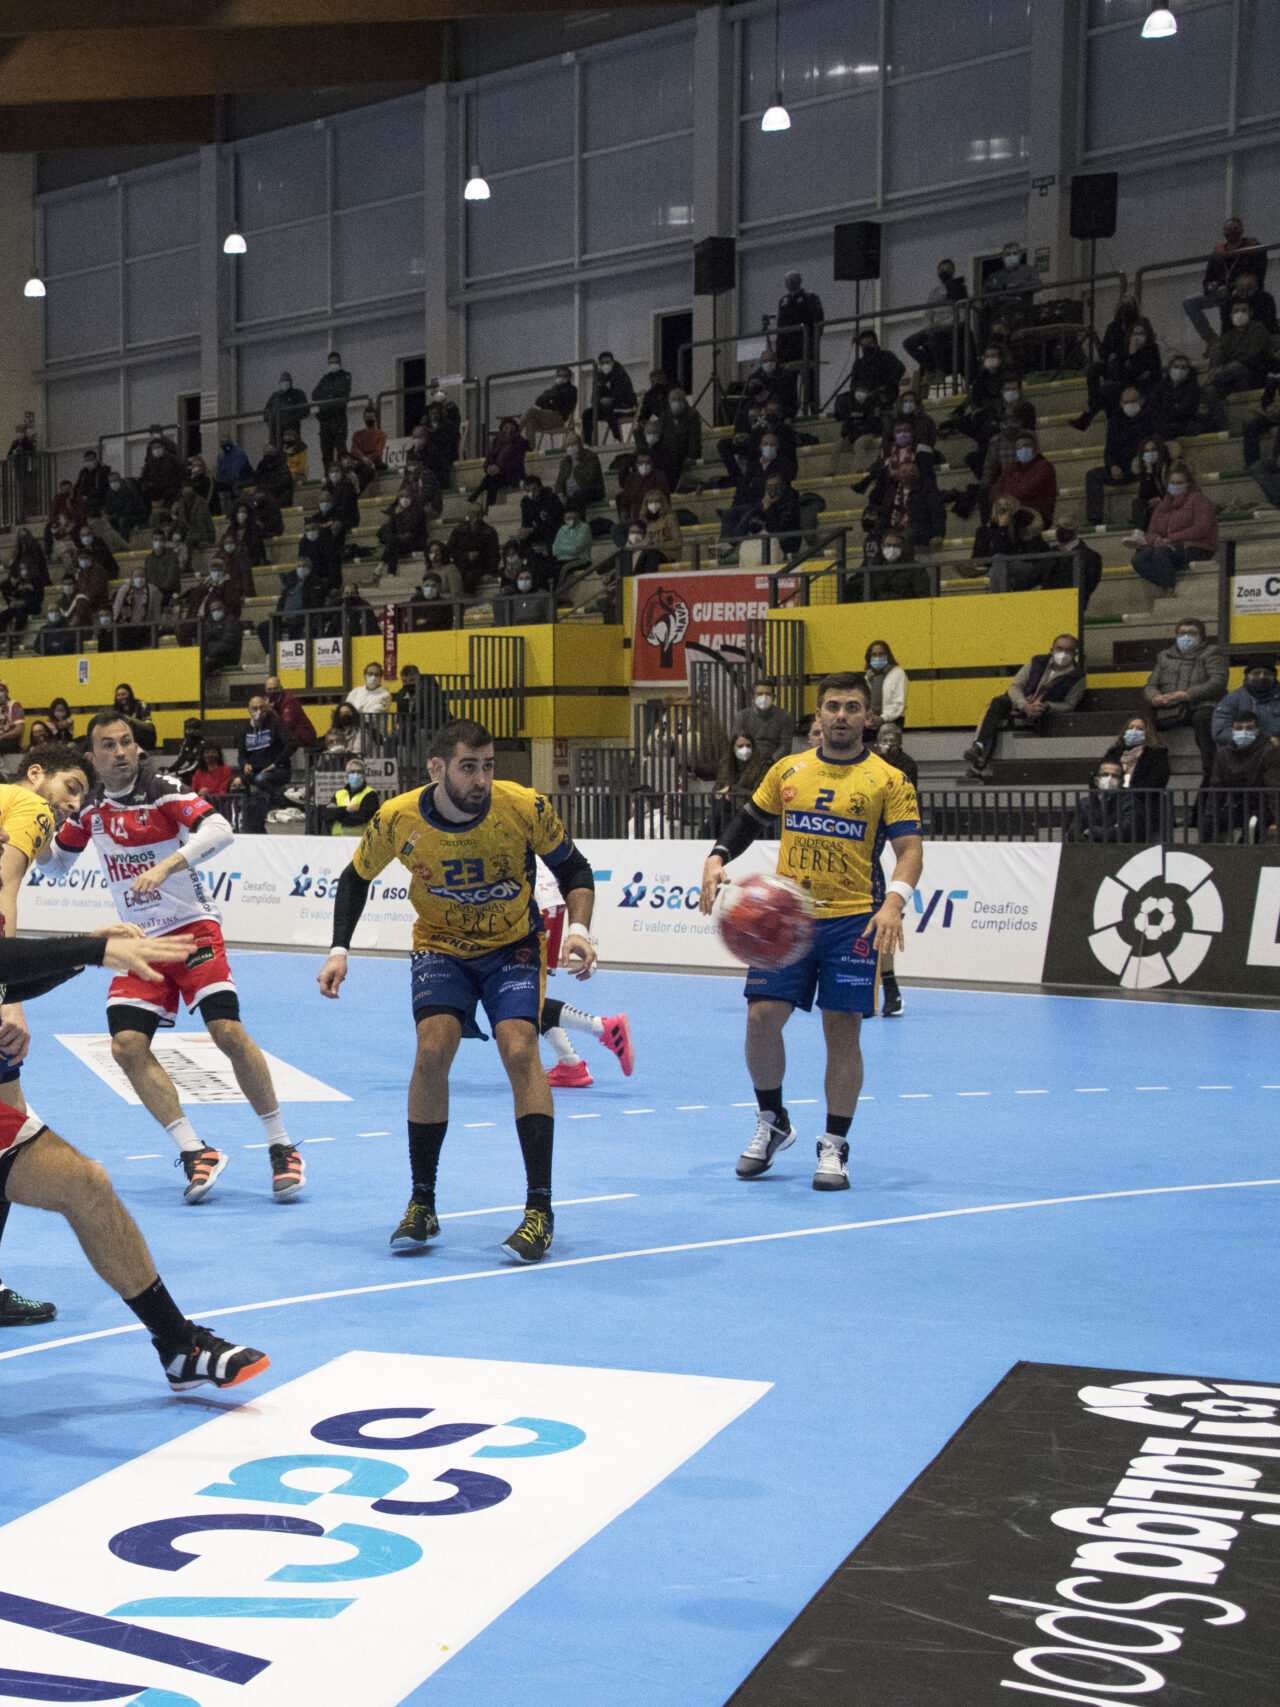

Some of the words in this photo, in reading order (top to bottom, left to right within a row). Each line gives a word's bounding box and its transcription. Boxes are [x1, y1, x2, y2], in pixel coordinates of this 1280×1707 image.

[1237, 587, 1261, 597] Zona
[295, 642, 304, 656] B
[331, 640, 340, 654] A
[384, 761, 395, 777] D
[815, 789, 835, 811] 2
[786, 813, 863, 838] BLASGON
[794, 836, 844, 851] BODEGAS
[788, 846, 848, 875] CERES
[441, 859, 485, 886] 23
[241, 894, 281, 905] cumplidos
[650, 886, 701, 910] sac
[973, 901, 1029, 915] Desafíos
[633, 920, 643, 932] El
[645, 920, 671, 932] valor
[674, 921, 687, 933] de
[971, 918, 1037, 933] cumplidos
